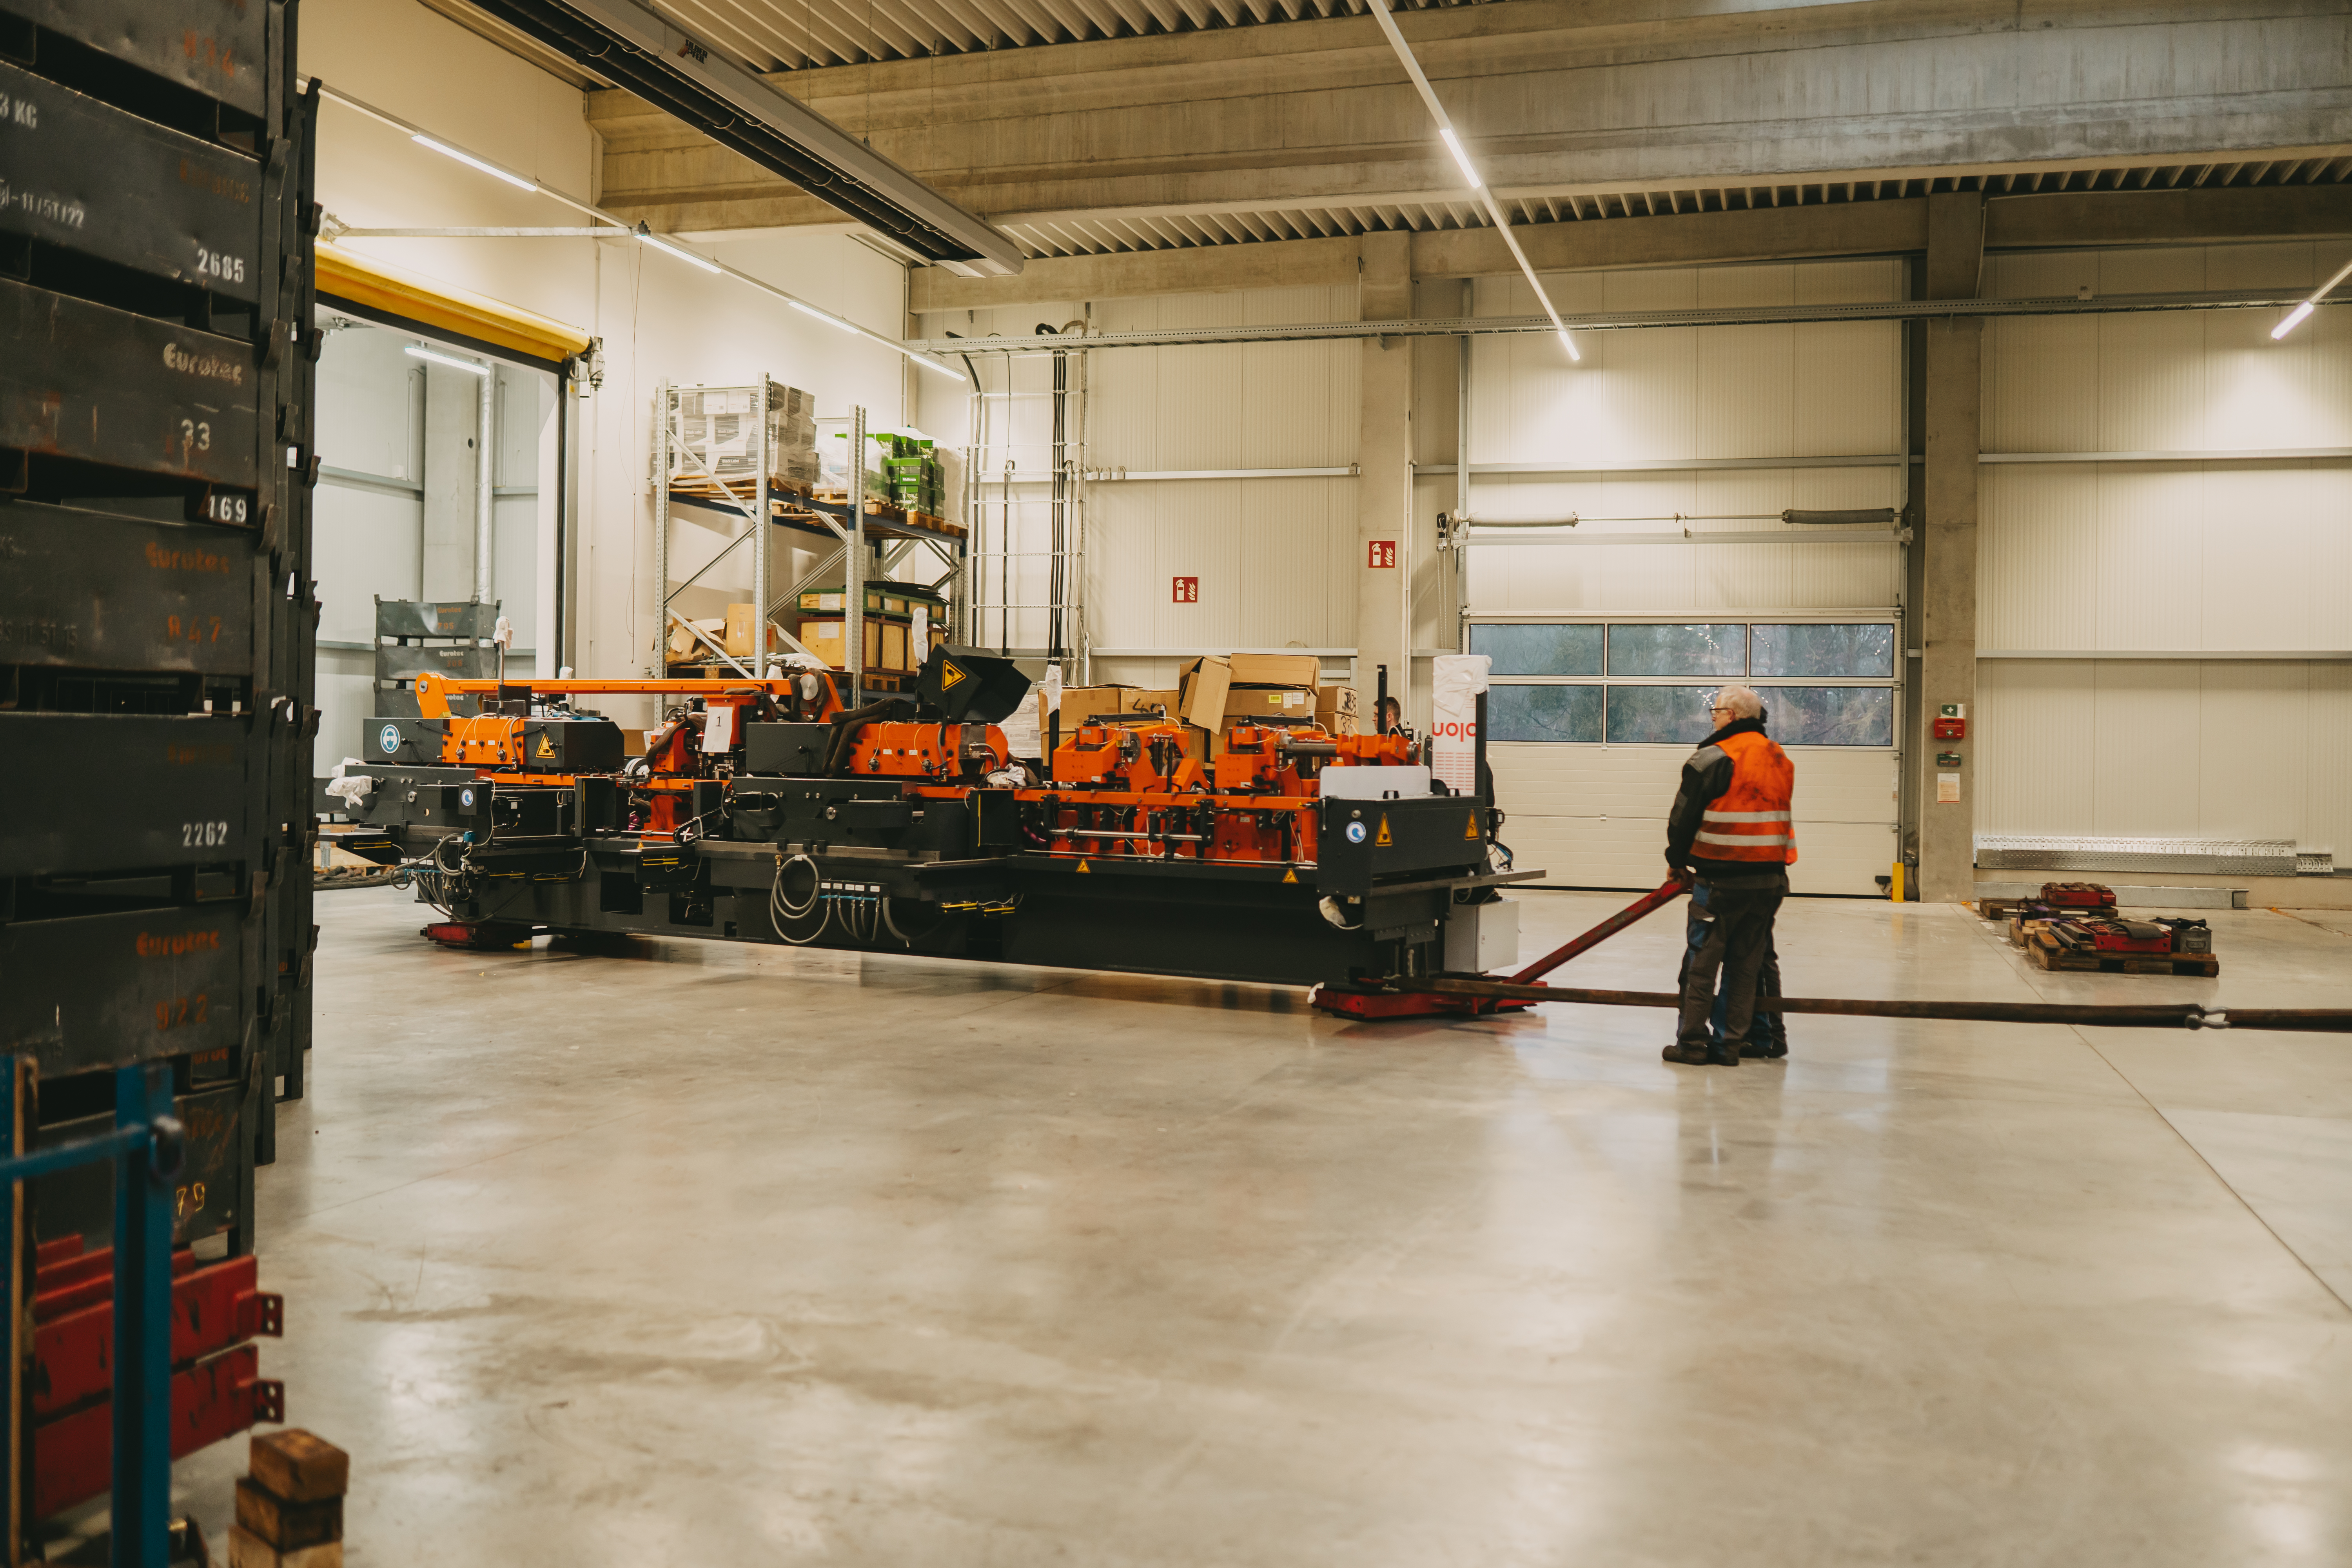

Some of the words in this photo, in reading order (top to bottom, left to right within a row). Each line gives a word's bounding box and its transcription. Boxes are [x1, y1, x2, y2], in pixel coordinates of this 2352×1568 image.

[686, 39, 708, 58] SILBER
[688, 47, 705, 65] PFEIL
[197, 247, 244, 283] 2685
[181, 418, 210, 451] 33
[209, 495, 247, 523] 169
[716, 716, 722, 727] 1
[183, 821, 228, 848] 2262
[156, 994, 207, 1031] 922
